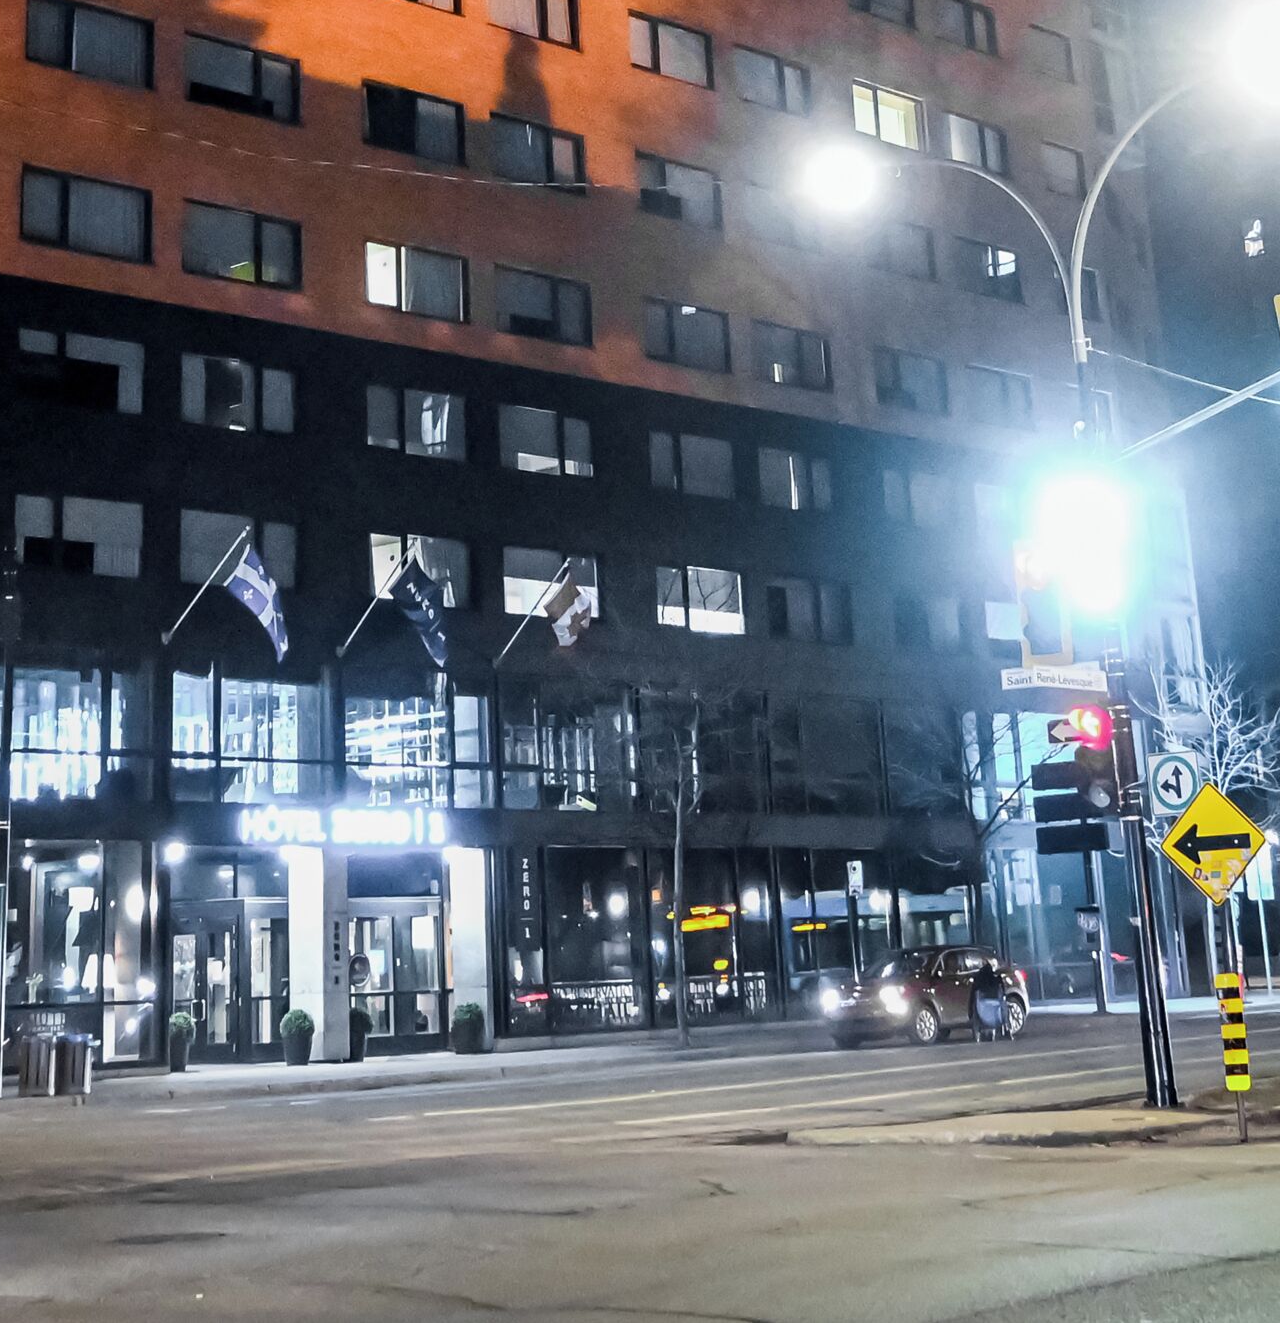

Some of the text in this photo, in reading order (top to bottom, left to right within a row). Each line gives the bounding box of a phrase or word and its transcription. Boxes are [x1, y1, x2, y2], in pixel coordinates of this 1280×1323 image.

[1006, 676, 1032, 686] Saint
[522, 858, 531, 938] ZERO 1
